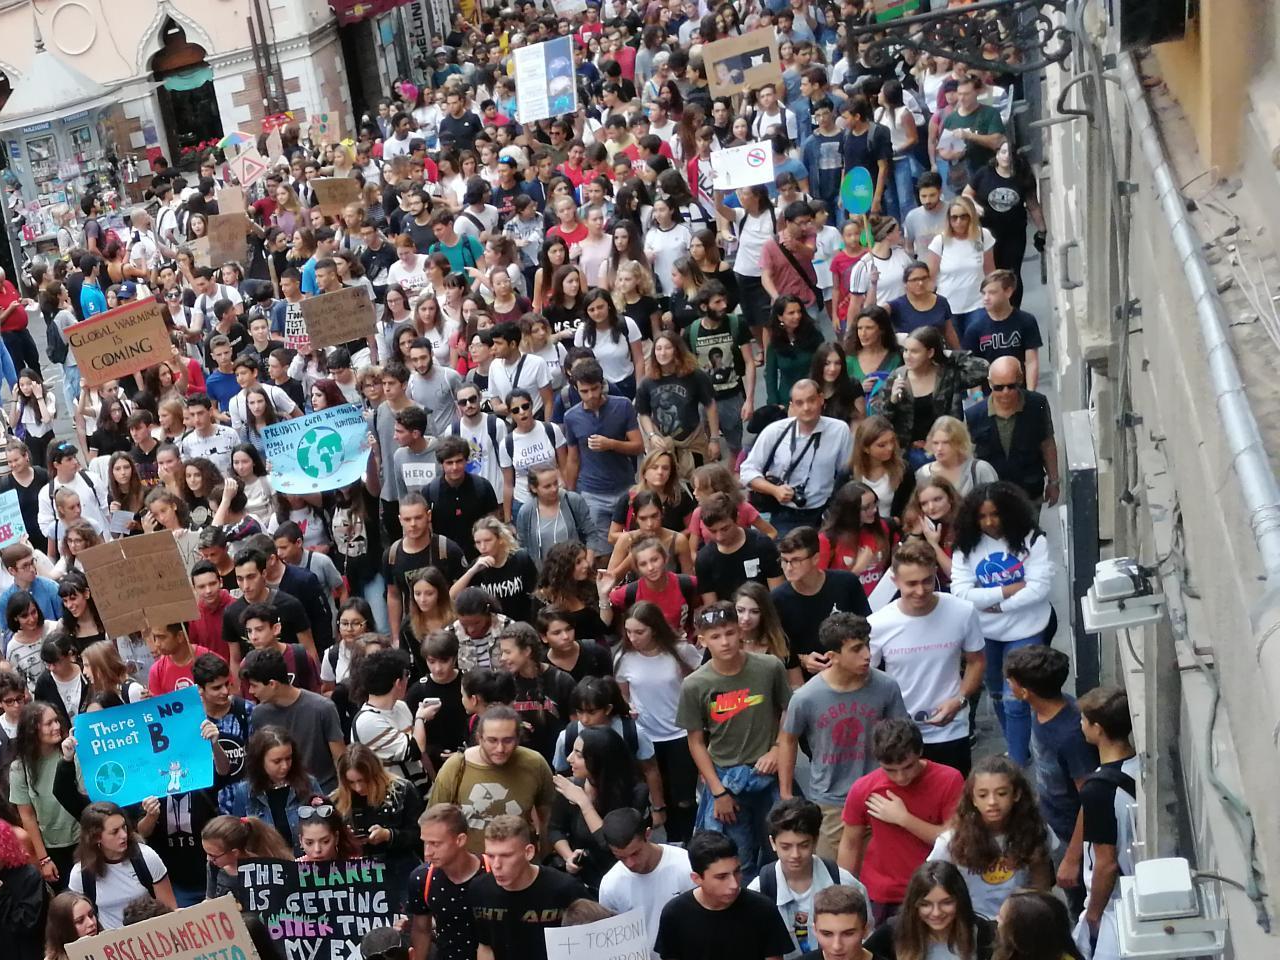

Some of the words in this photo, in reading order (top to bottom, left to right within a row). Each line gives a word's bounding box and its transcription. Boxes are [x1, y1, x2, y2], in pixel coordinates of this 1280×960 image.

[69, 325, 115, 347] GLOBAL
[979, 330, 1022, 351] FILA
[91, 337, 153, 371] COMING
[405, 468, 434, 479] HERO
[979, 569, 1022, 586] NASA
[89, 718, 136, 738] There
[142, 713, 154, 723] is
[157, 701, 184, 719] NO
[90, 731, 140, 756] Planet
[148, 722, 170, 754] B
[238, 863, 284, 888] THE
[297, 861, 387, 888] PLANET
[585, 920, 644, 949] TORBONI
